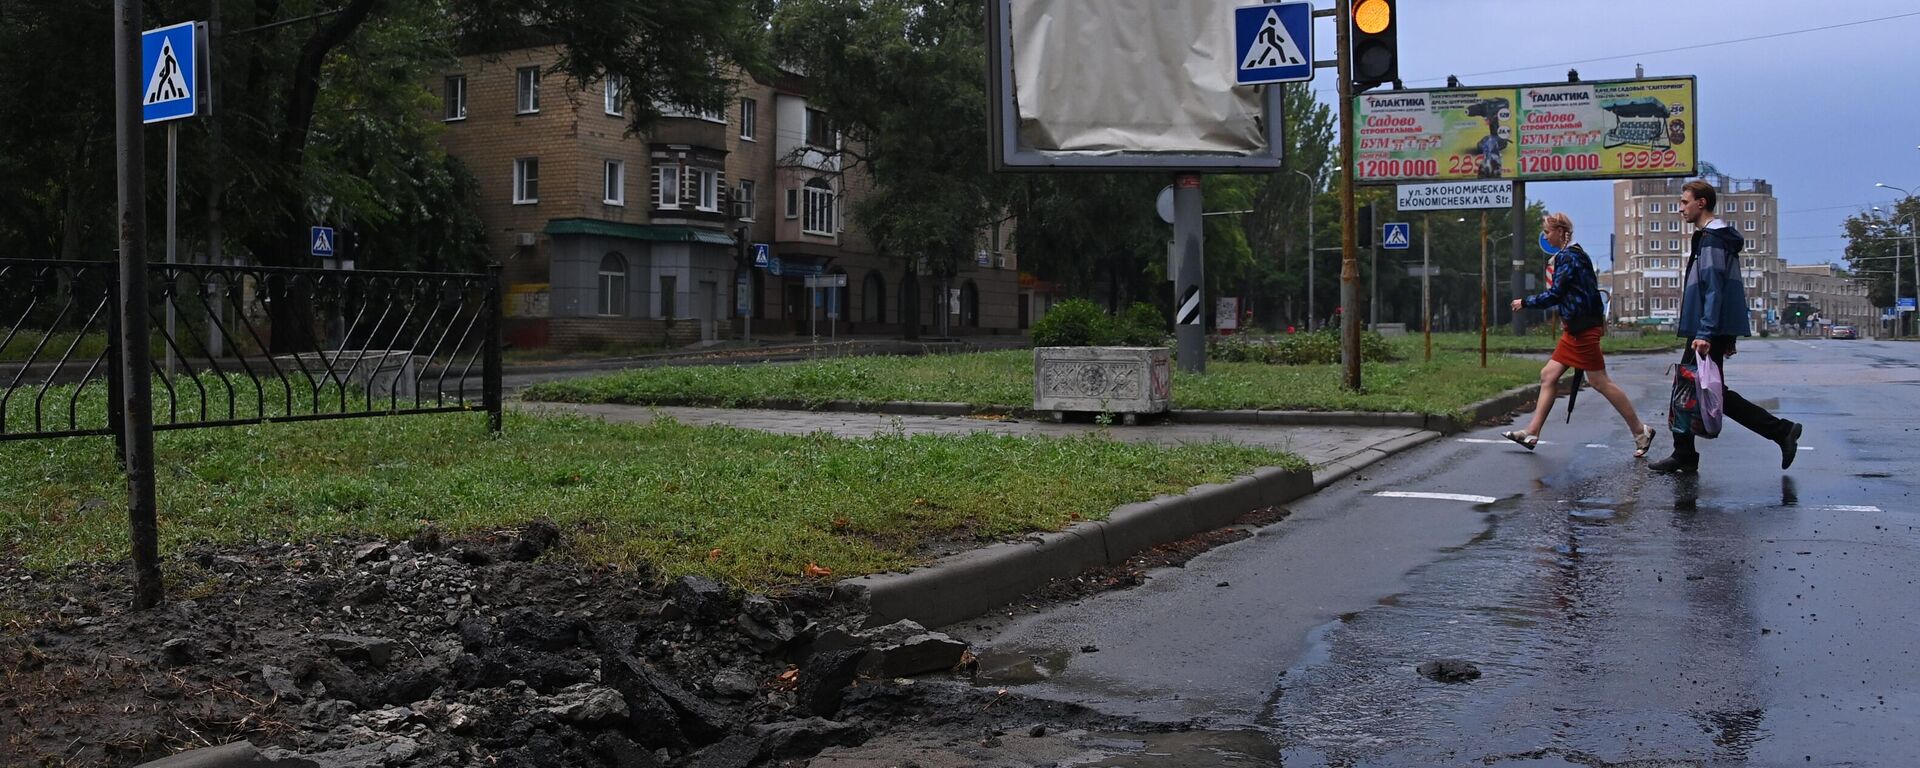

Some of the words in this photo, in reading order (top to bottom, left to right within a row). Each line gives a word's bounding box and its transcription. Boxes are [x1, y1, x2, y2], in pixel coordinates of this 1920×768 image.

[1370, 97, 1425, 108] ГАЛАКТИКА
[1532, 91, 1590, 103] ГАЛАКТИКА
[1367, 114, 1415, 127] Садово
[1526, 111, 1575, 123] Садово
[1360, 125, 1423, 135] СТРОИТЕЛЬНЫЙ
[1520, 121, 1583, 131] СТРОИТЕЛЬНЫЙ
[1360, 137, 1390, 149] БУМ
[1520, 133, 1550, 144] БУМ
[1616, 150, 1676, 169] 19999
[1408, 190, 1422, 200] ул.
[1425, 184, 1512, 196] ЭКОНОМИЧЕСКАЯ
[1400, 196, 1490, 207] EKONOMICHESKAYA
[1495, 195, 1511, 204] Str.
